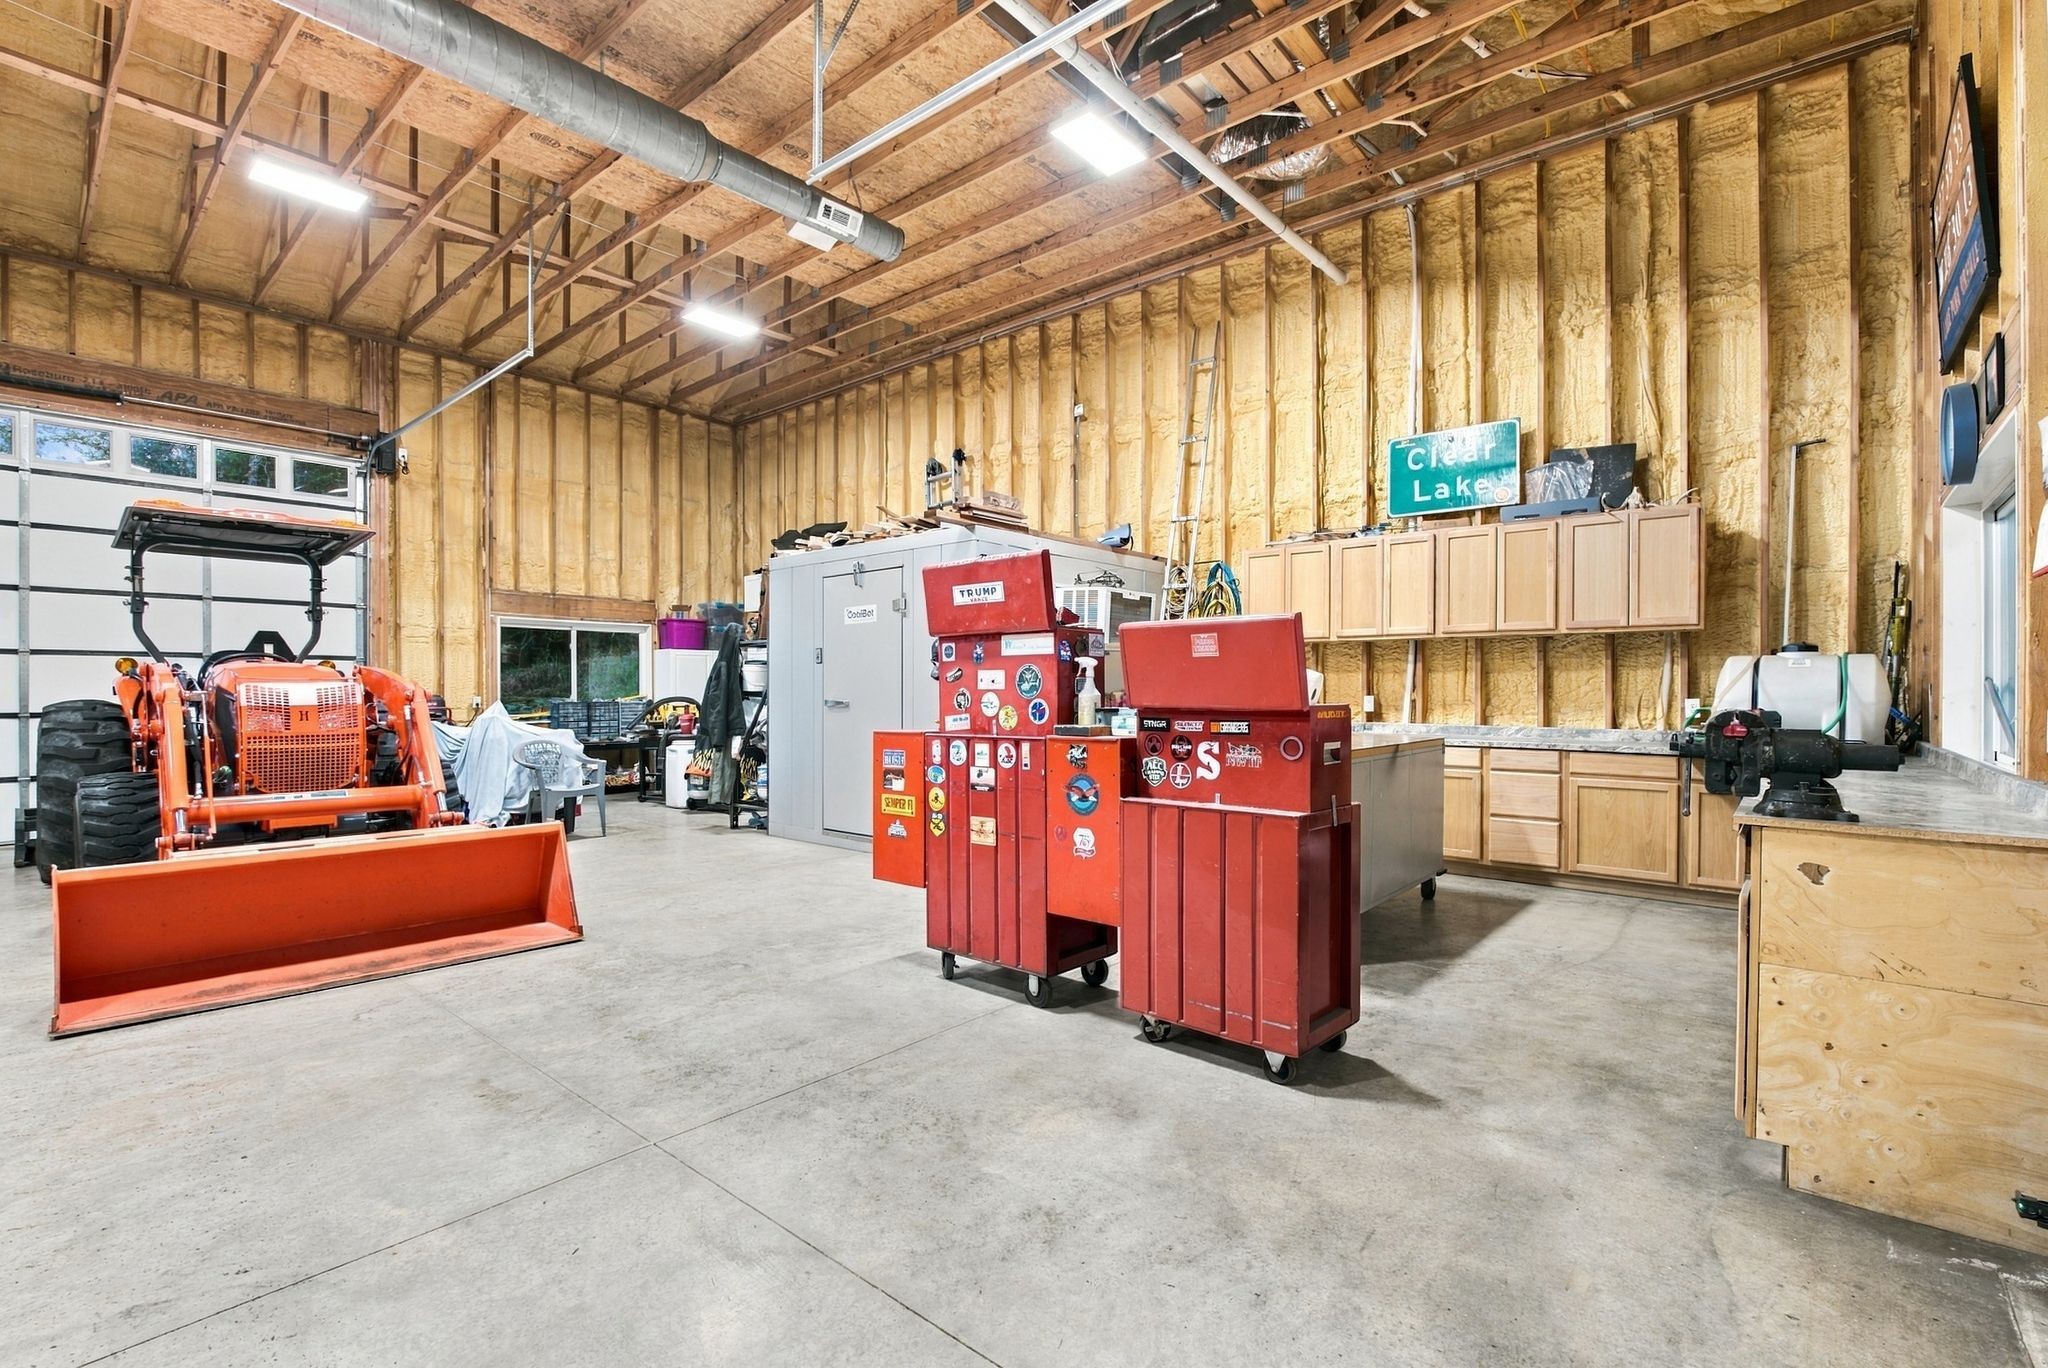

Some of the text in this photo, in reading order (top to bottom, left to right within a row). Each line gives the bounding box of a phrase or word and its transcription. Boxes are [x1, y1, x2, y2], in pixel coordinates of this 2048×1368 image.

[160, 390, 199, 405] APA
[1407, 442, 1497, 471] Clear
[1413, 475, 1489, 502] Lake
[959, 586, 997, 598] TRUMP
[884, 797, 906, 810] SEMPER
